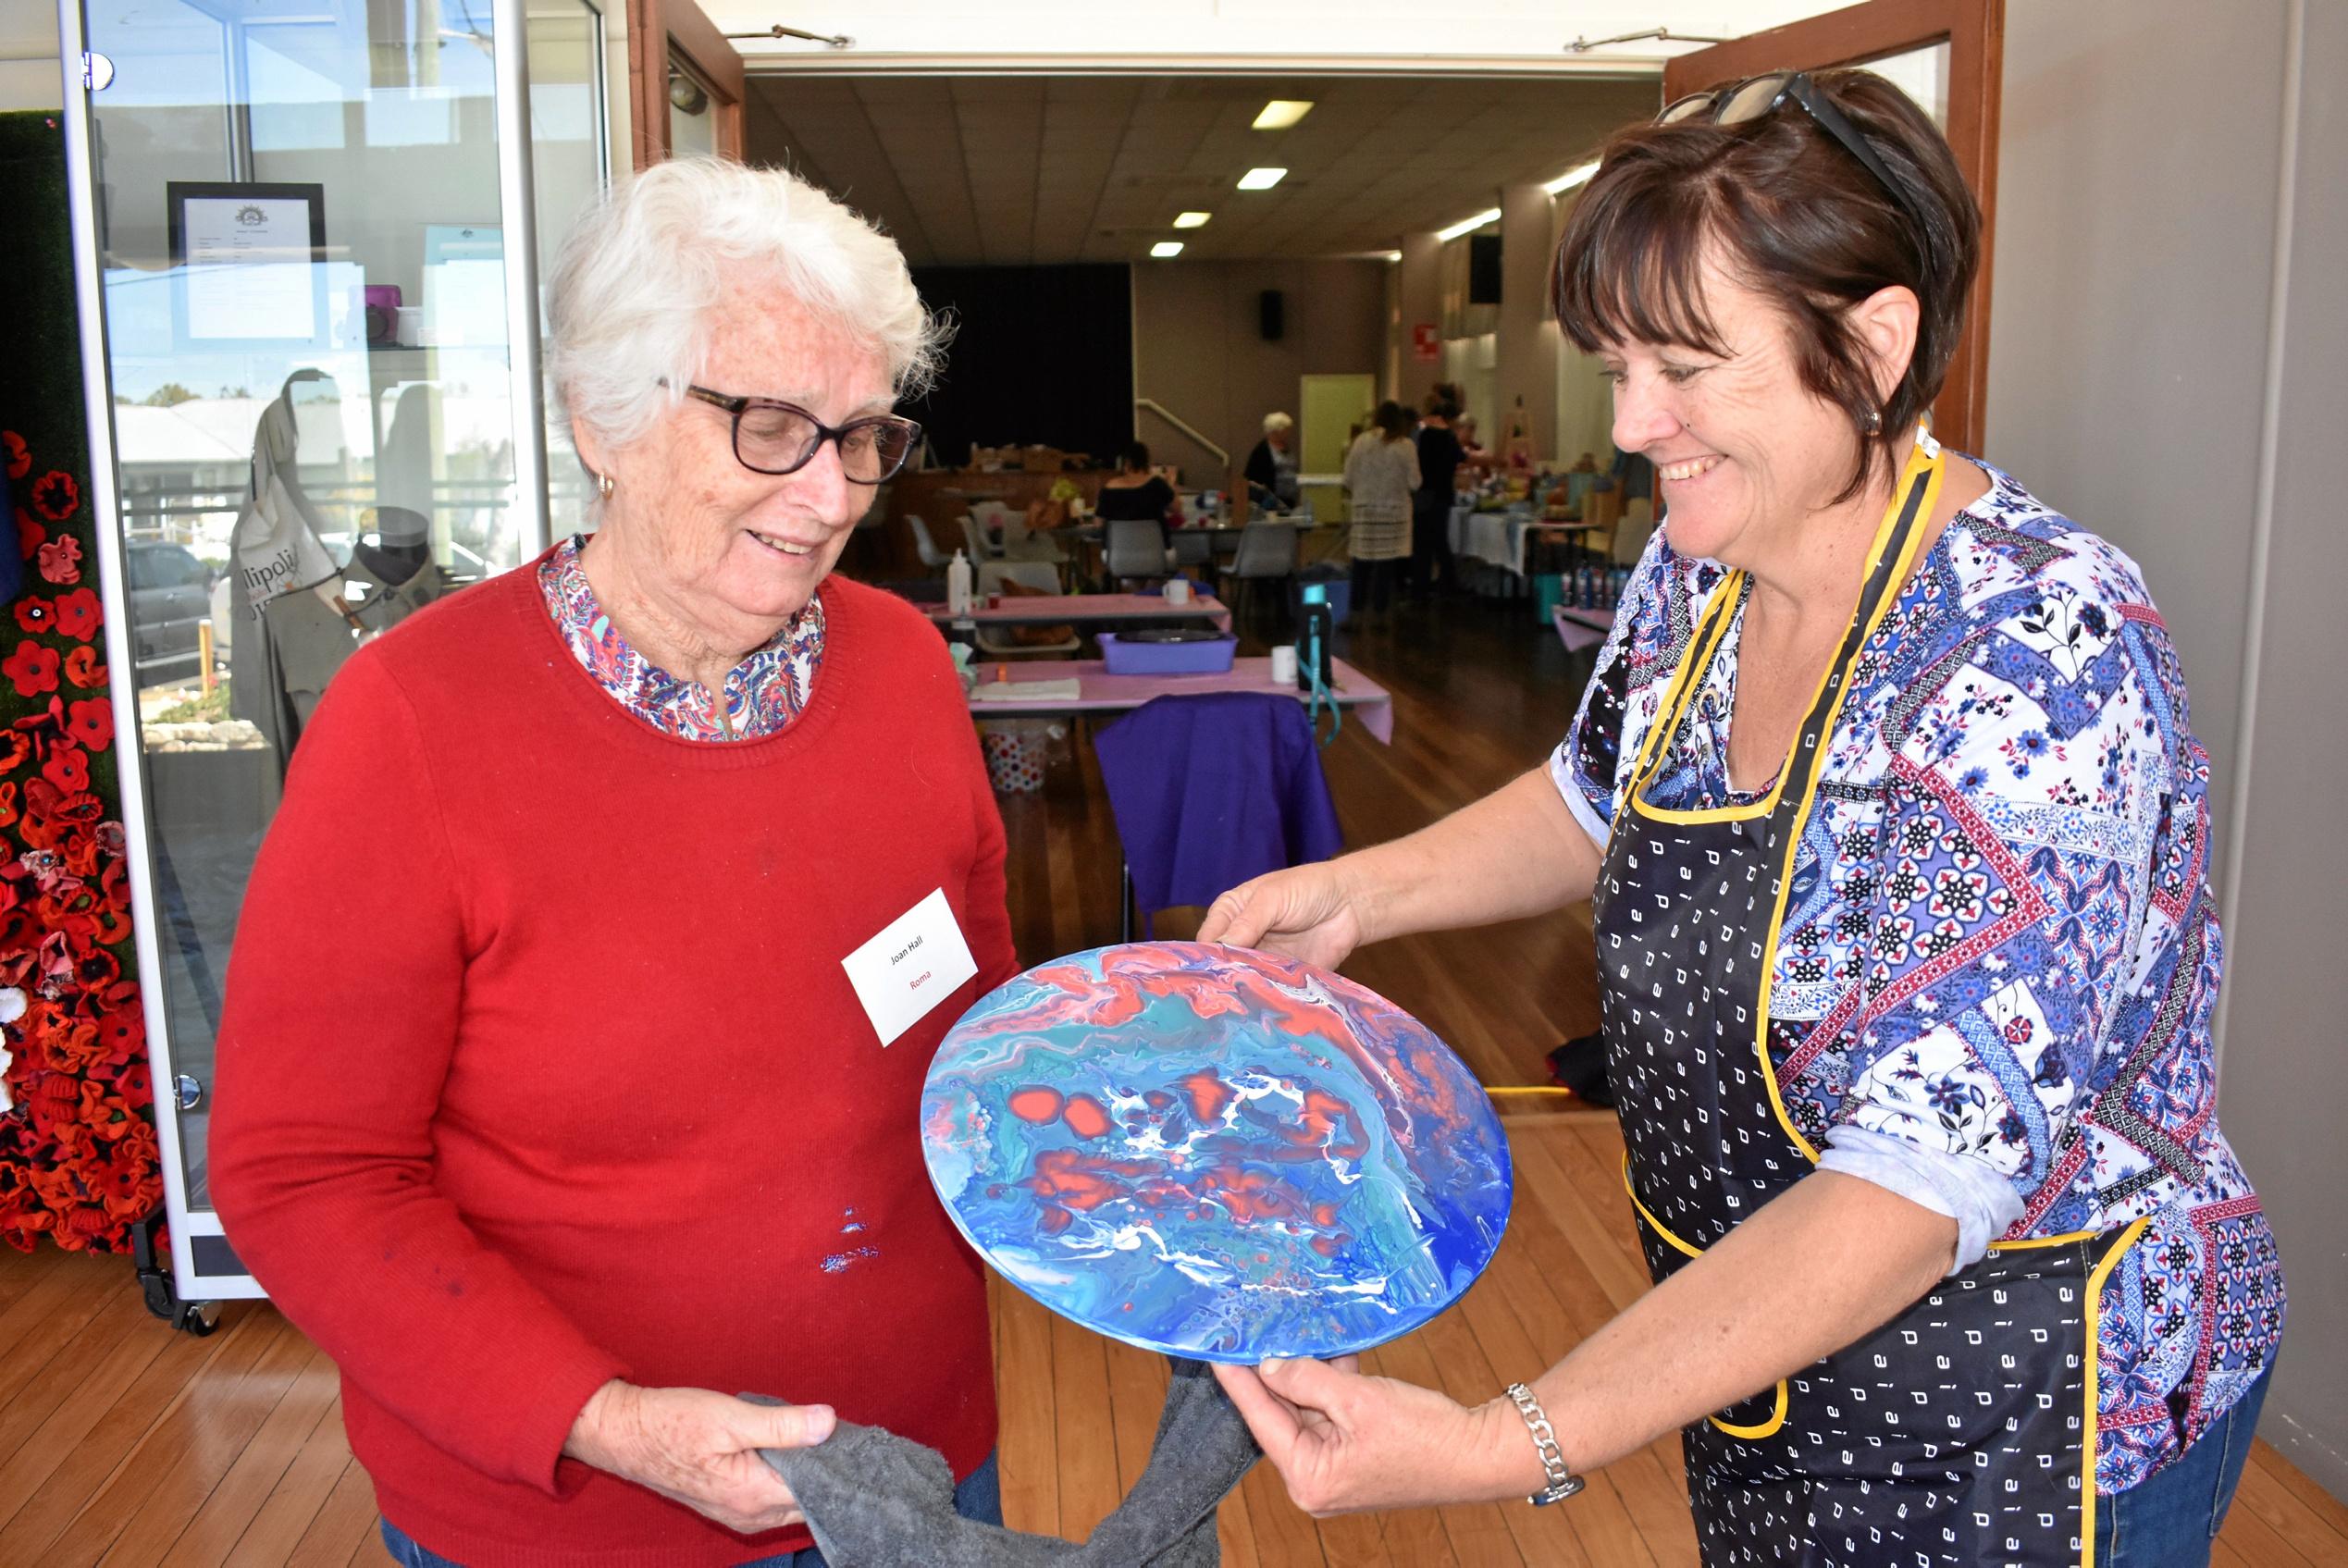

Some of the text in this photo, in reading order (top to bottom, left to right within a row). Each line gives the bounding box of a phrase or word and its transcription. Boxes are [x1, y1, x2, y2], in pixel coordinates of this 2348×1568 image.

[891, 935, 923, 966] Joan Hall
[909, 970, 932, 990] Roma
